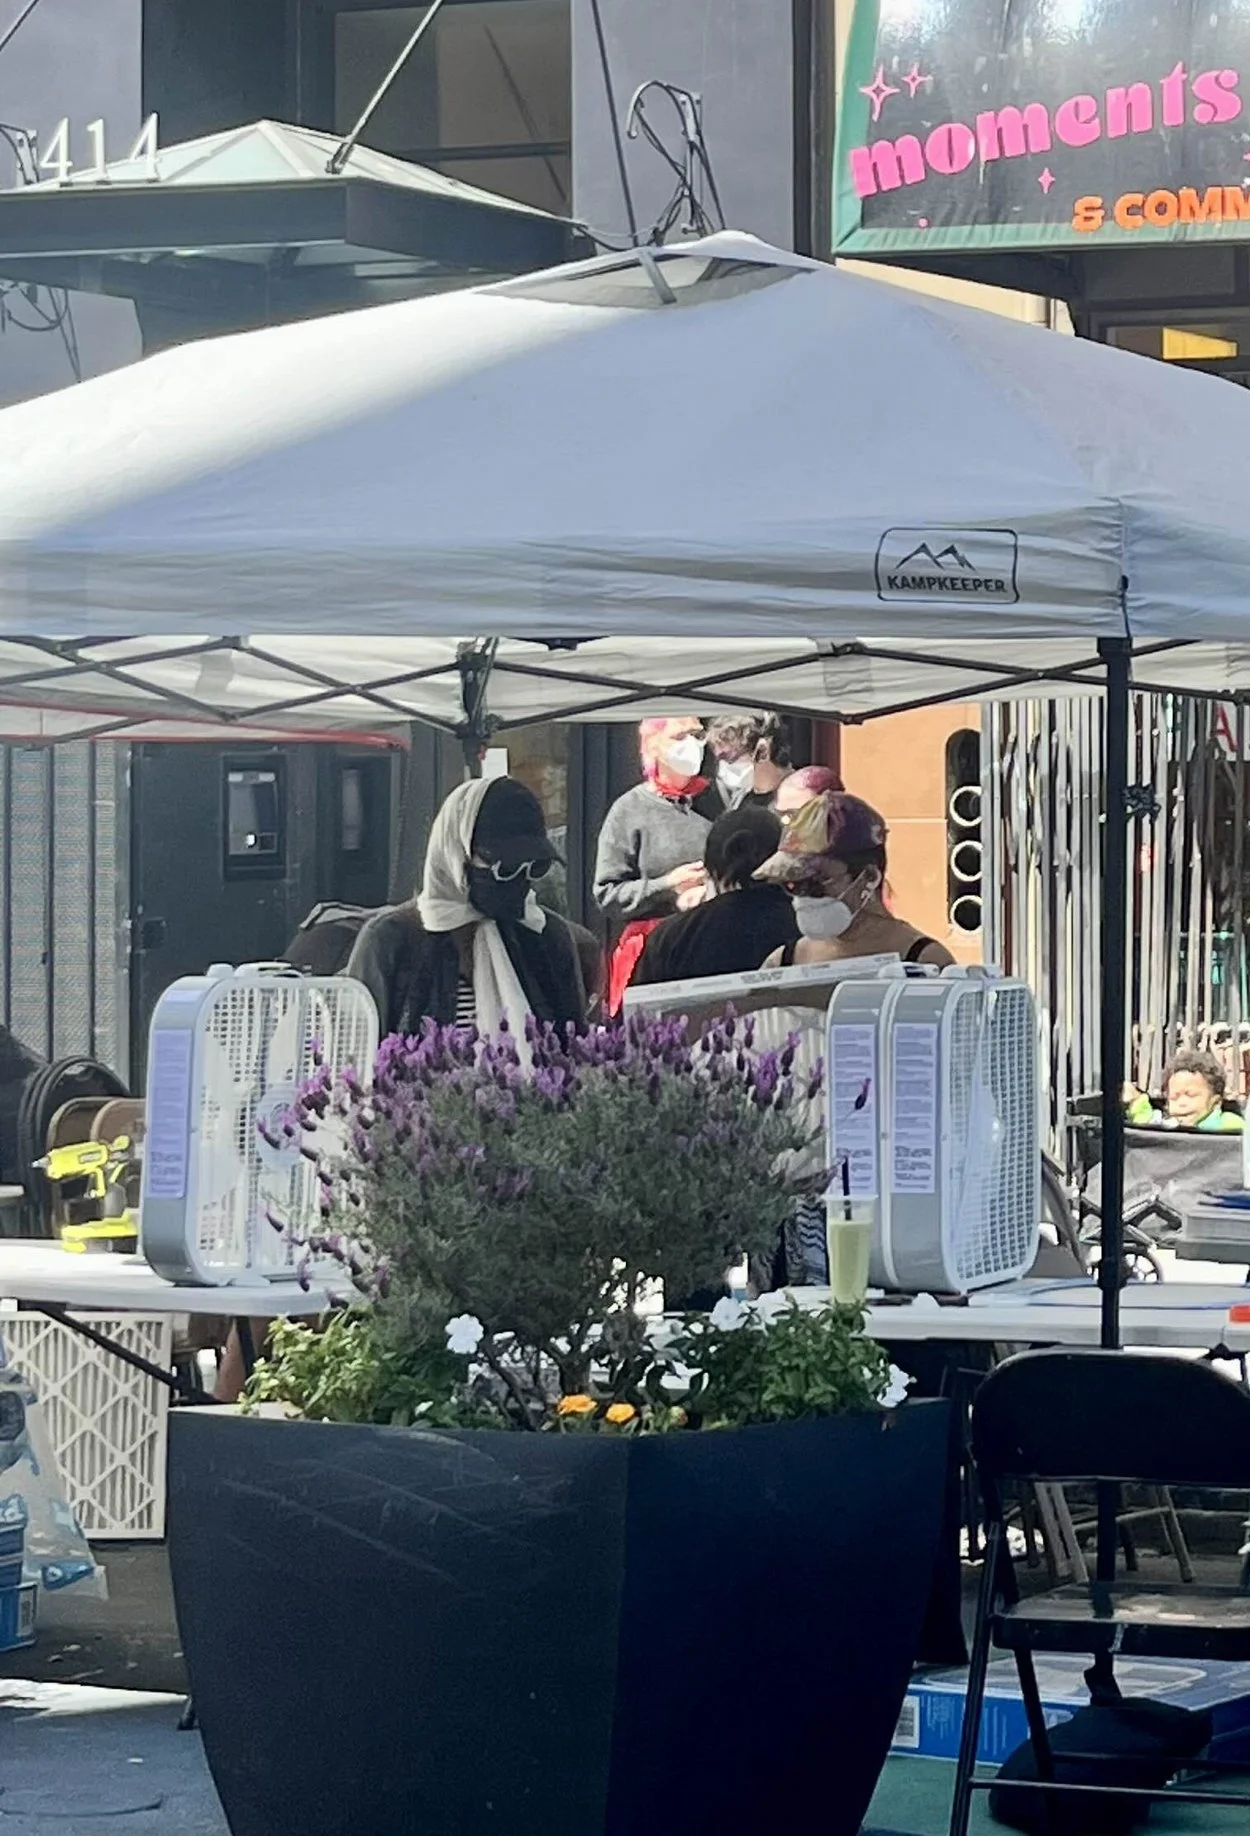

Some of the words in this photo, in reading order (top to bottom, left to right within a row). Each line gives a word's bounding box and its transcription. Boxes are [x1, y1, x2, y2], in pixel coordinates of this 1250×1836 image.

[40, 110, 161, 184] 414
[849, 61, 1242, 198] moments
[1071, 194, 1104, 231] &
[887, 574, 1008, 593] KAMPKEEPER
